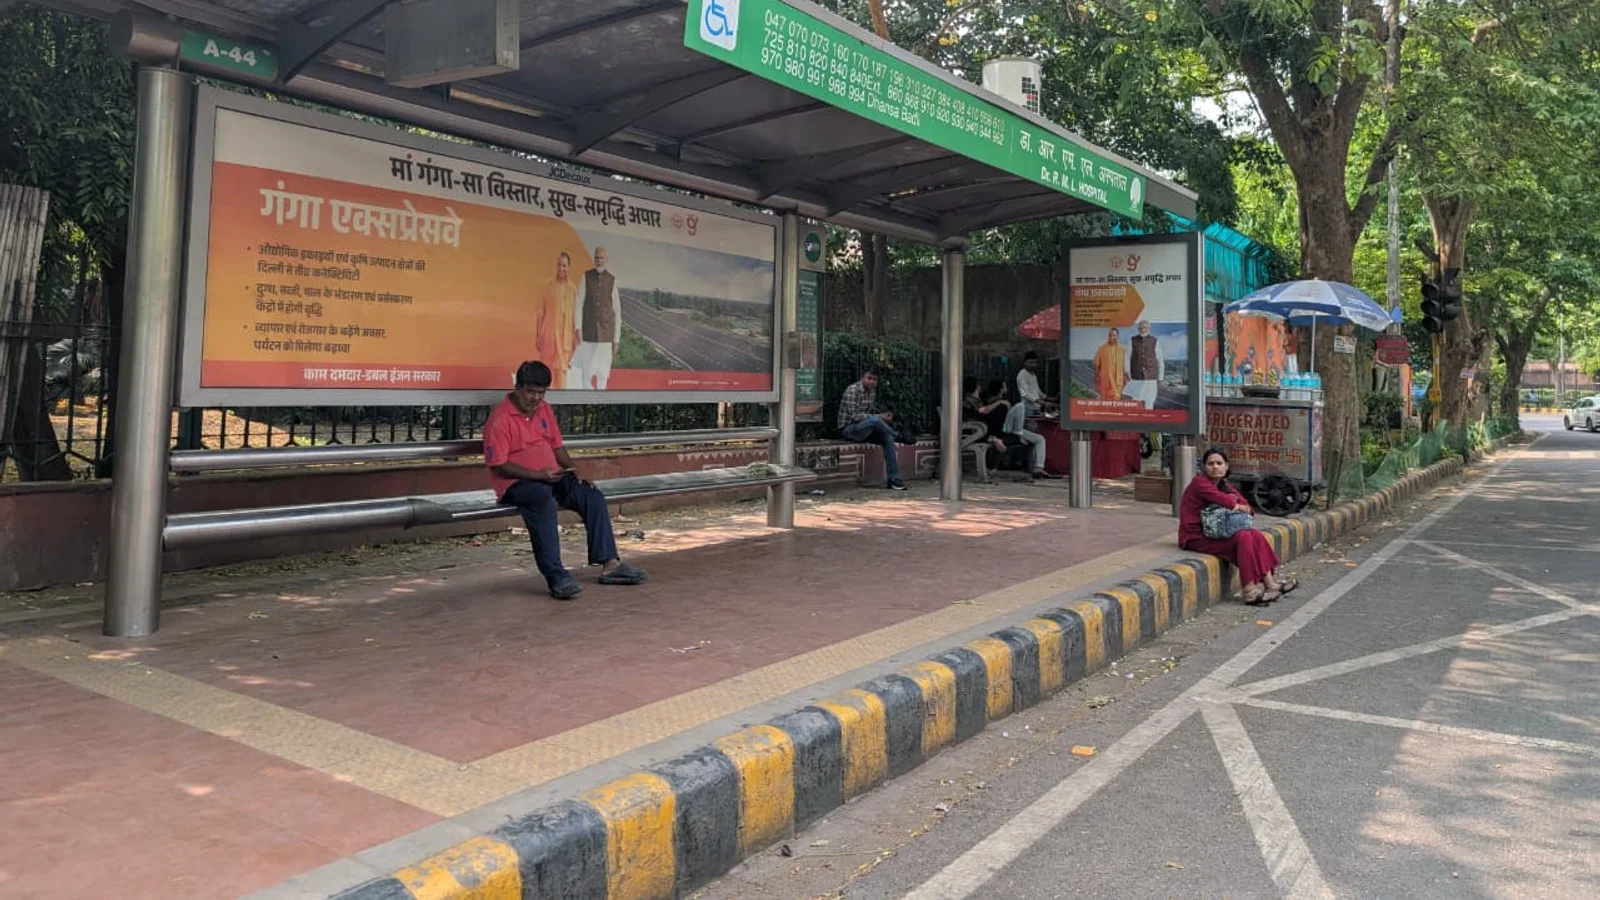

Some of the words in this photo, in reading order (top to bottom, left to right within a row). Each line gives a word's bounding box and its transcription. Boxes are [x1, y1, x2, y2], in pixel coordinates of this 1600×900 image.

[203, 40, 256, 66] A-44
[765, 10, 786, 30] 047
[789, 21, 808, 42] 070
[811, 32, 830, 52] 073
[832, 42, 849, 62] 160
[853, 52, 868, 70] 170
[872, 61, 887, 78] 187
[906, 76, 920, 94] 310
[762, 48, 782, 70] 970
[785, 58, 805, 79] 980
[808, 68, 825, 87] 991
[868, 93, 900, 118] Dhansa
[763, 28, 784, 51] 725
[787, 39, 806, 61] 810
[809, 50, 828, 70] 820
[830, 59, 848, 80] 840
[921, 100, 935, 117] 910
[549, 166, 591, 185] JCDecaux
[1039, 139, 1057, 163] आर.
[1099, 166, 1128, 192] अस्पताल
[389, 153, 413, 181] मां
[417, 158, 484, 195] गंगा-सा
[486, 172, 544, 209] विस्तार,
[548, 189, 626, 226] सुख-समृद्धि
[628, 206, 661, 228] अपार
[1041, 166, 1051, 182] Dr.
[1053, 171, 1060, 186] R.
[1079, 181, 1108, 204] HOSPITAL
[260, 180, 324, 230] गंगा
[330, 200, 463, 248] एक्सप्रेसवे
[258, 242, 299, 258] औद्योगिक
[350, 254, 368, 267] कृषि
[370, 256, 396, 268] उत्पादन
[415, 259, 426, 271] की
[258, 260, 283, 274] दिल्ली
[255, 322, 283, 333] व्यापार
[254, 339, 281, 351] पर्यटन
[304, 368, 326, 380] काम
[330, 368, 387, 382] दमदार-डबल
[390, 367, 410, 384] इंजन
[413, 370, 441, 383] सरकार
[1242, 431, 1284, 446] WATER
